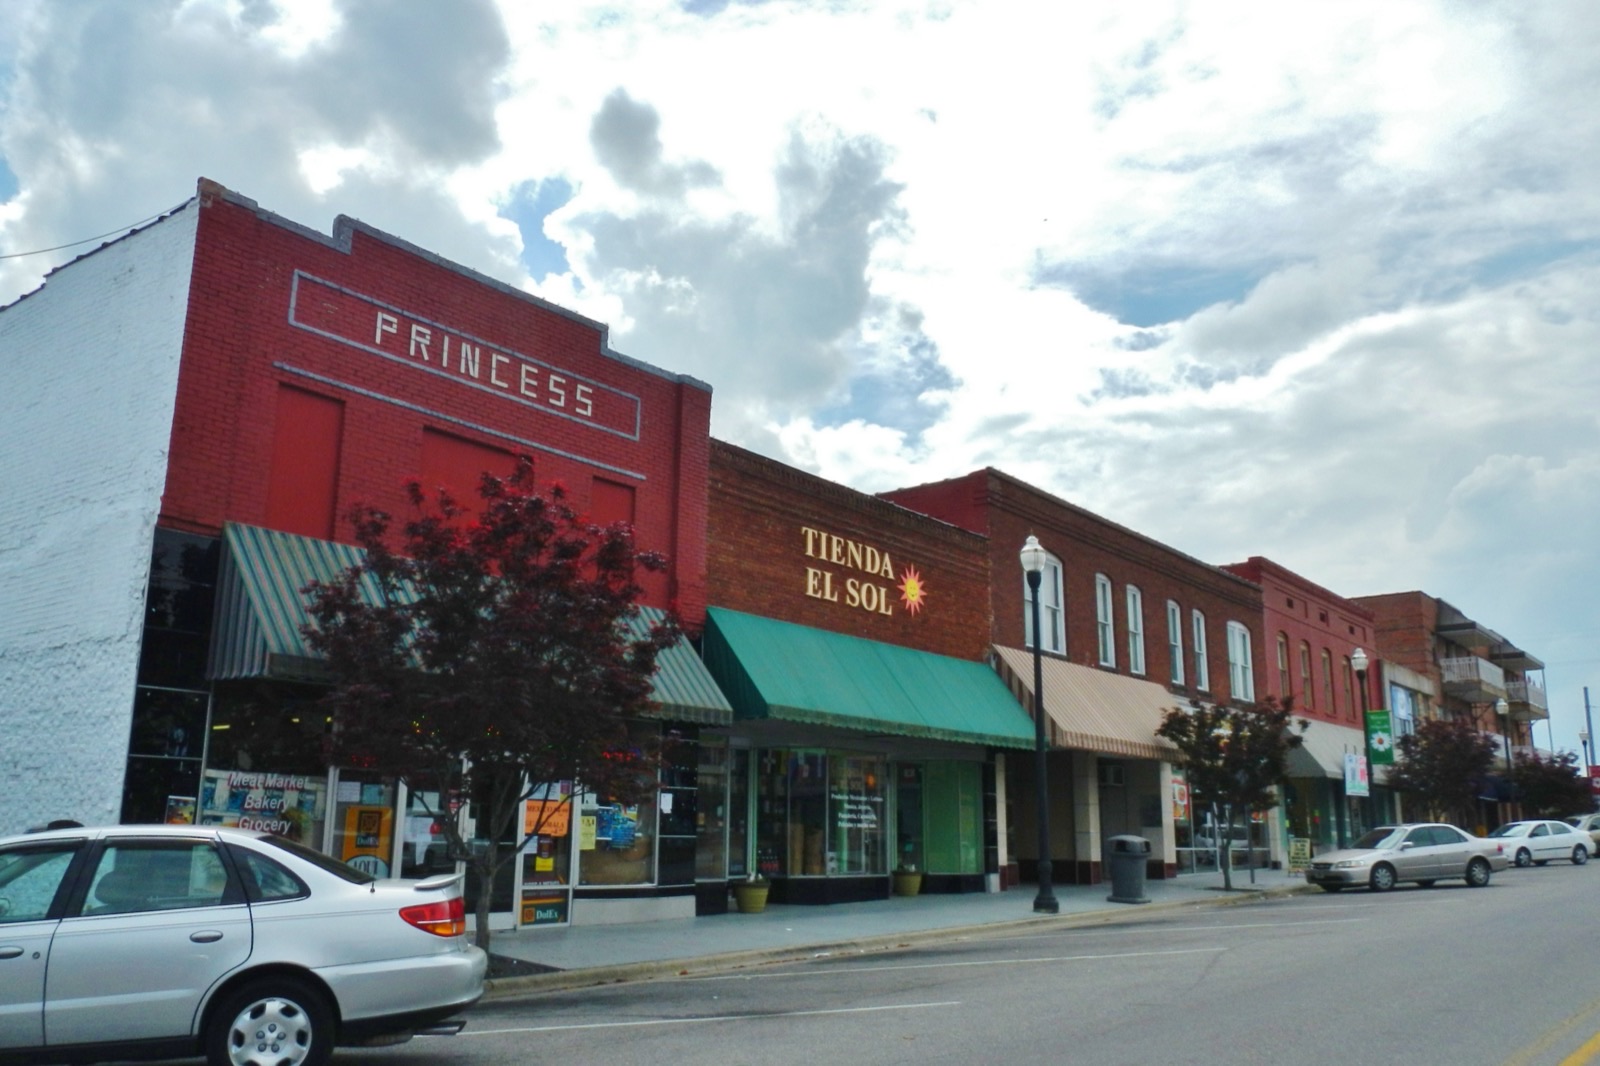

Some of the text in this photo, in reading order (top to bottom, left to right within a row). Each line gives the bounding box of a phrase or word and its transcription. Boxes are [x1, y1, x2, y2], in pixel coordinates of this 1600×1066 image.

[375, 311, 593, 417] PRINCESS
[801, 526, 895, 580] TIENDA
[805, 566, 892, 616] EL SOL
[228, 771, 310, 790] Meat Market
[243, 794, 290, 813] Bakery
[239, 816, 292, 835] Grocery
